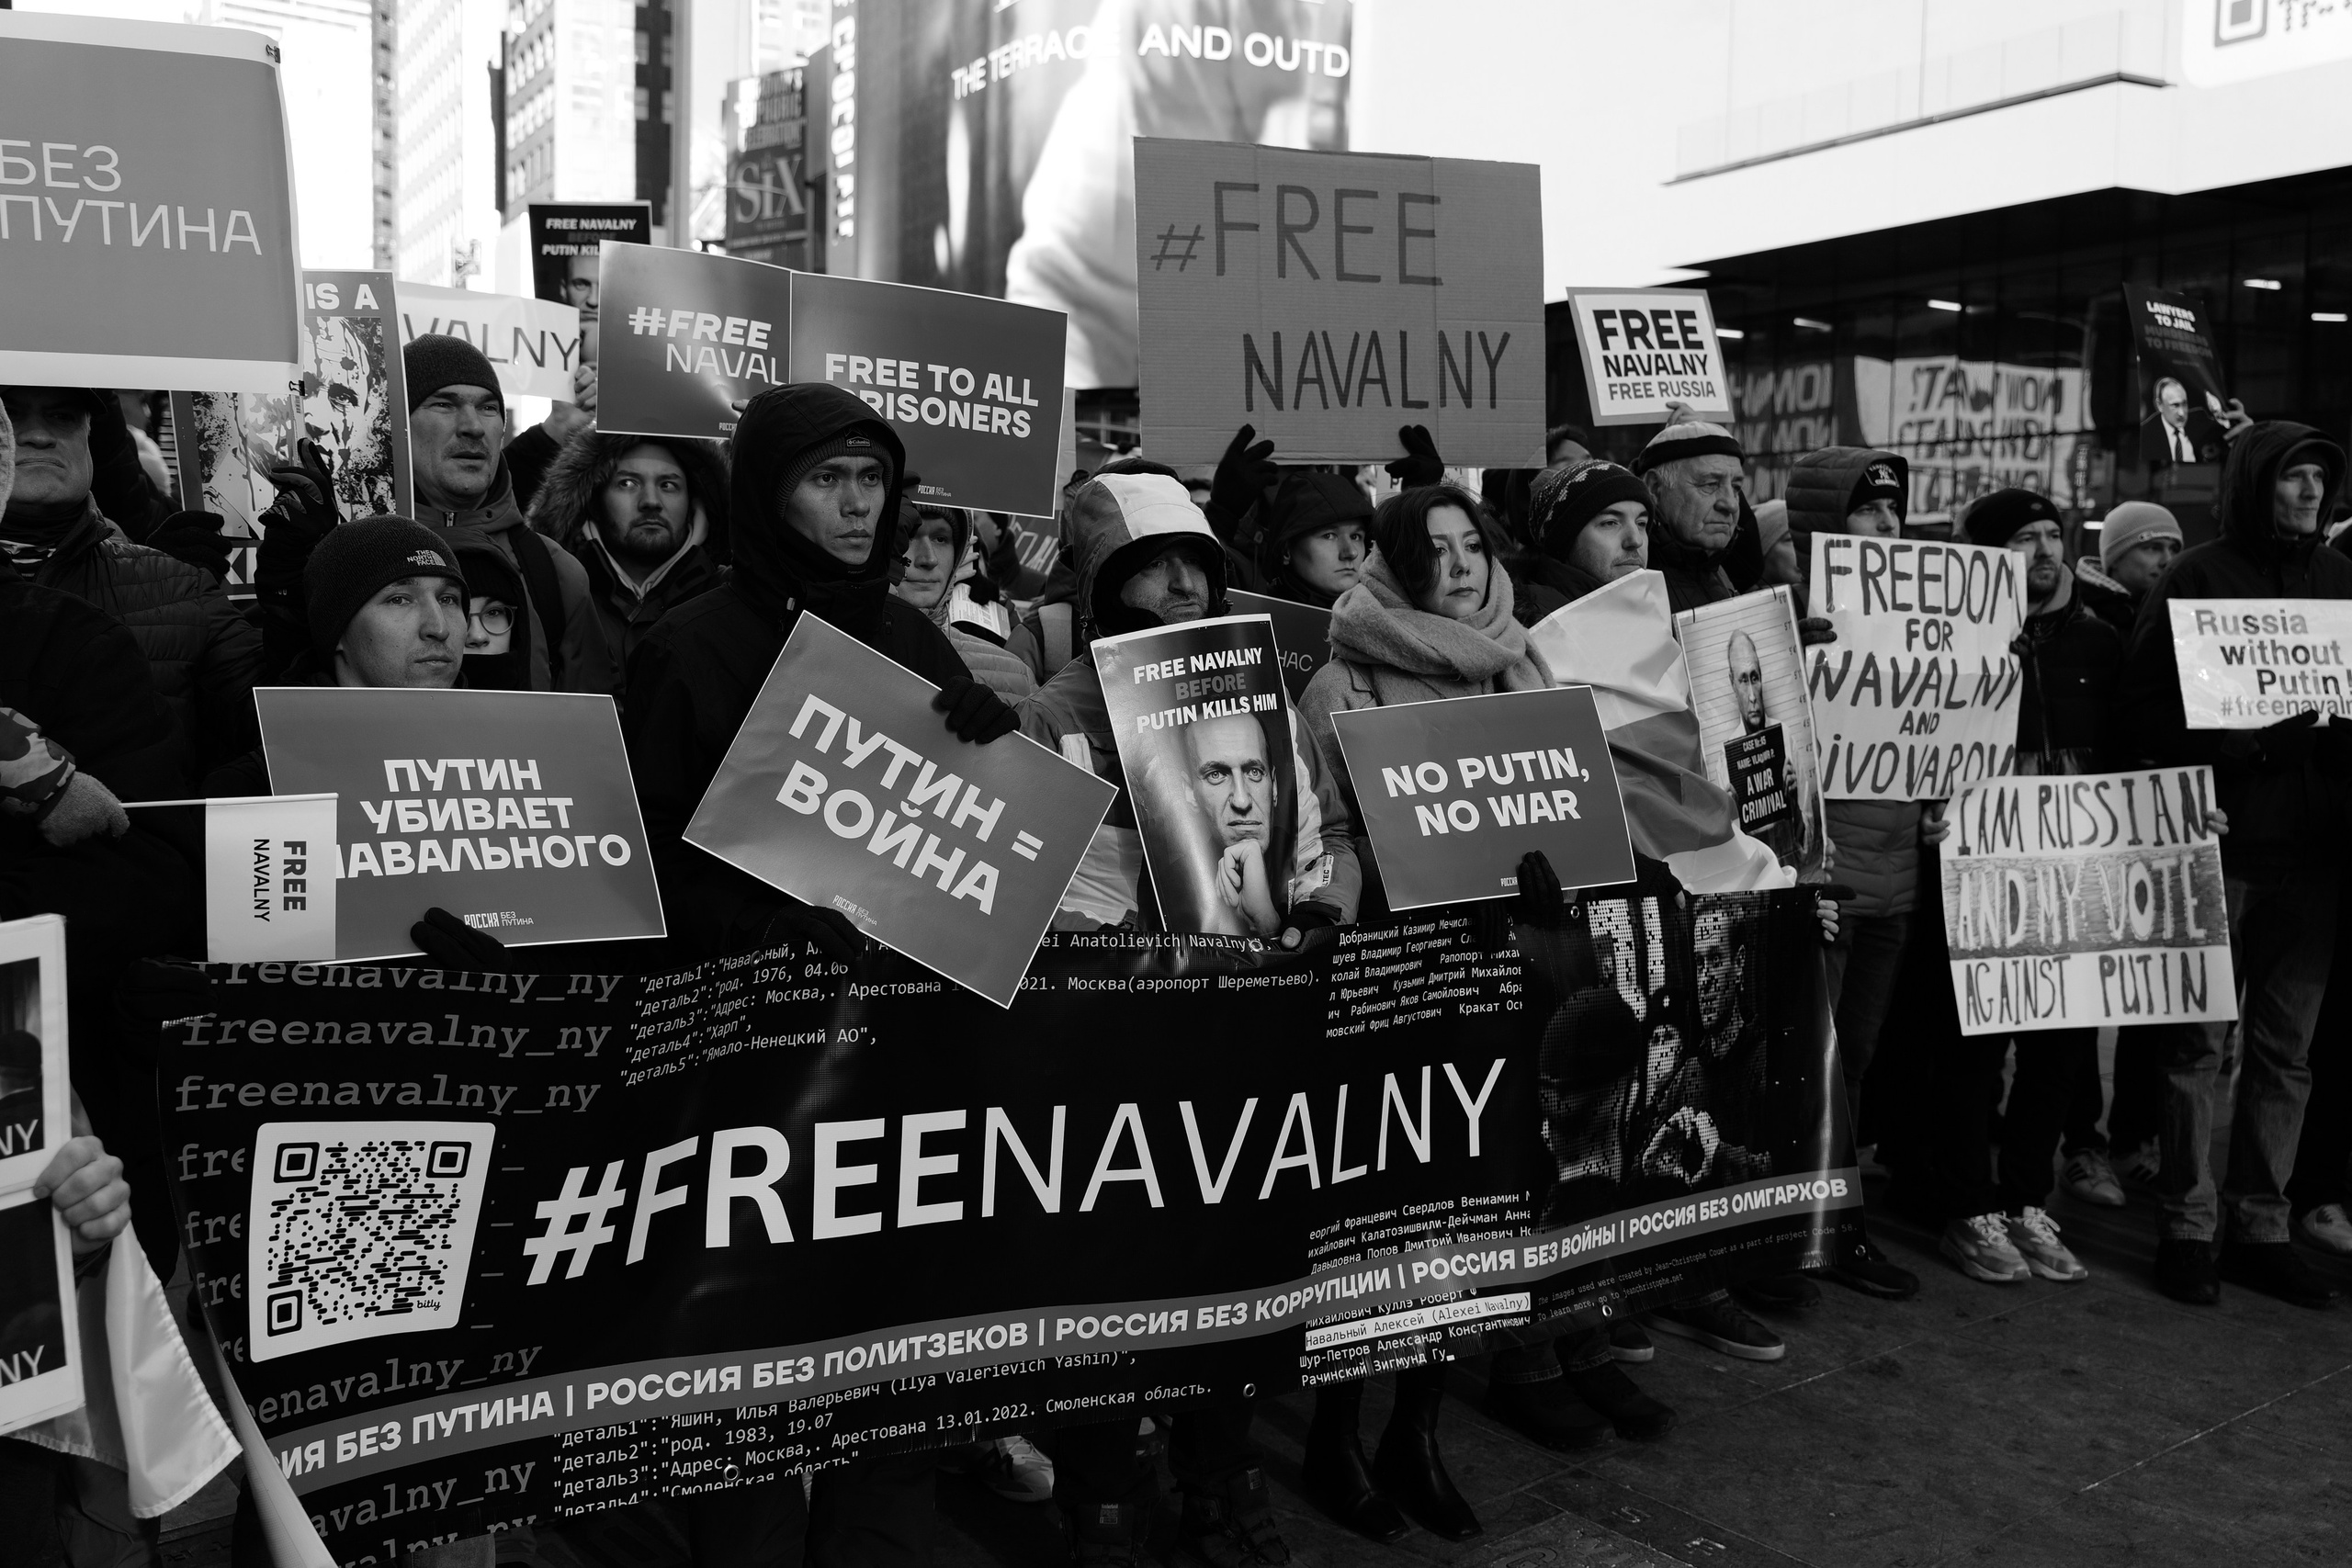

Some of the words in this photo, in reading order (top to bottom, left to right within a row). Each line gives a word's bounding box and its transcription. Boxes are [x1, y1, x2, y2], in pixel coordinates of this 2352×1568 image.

[951, 56, 987, 100] THE
[1137, 23, 1233, 61] AND
[1243, 31, 1351, 78] OUTD
[0, 140, 122, 192] БЕЗ
[0, 194, 263, 256] ПУТИНА
[545, 218, 578, 230] FREE
[579, 218, 638, 231] NAVALNY
[1150, 180, 1443, 287] #FREE
[541, 244, 579, 256] PUTIN
[305, 283, 340, 310] IS
[354, 283, 379, 310] A
[2146, 300, 2196, 322] LAWYERS
[628, 306, 772, 351] #FREE
[1592, 310, 1704, 351] FREE
[2154, 313, 2172, 327] TO
[2173, 317, 2196, 333] JAIL
[825, 353, 920, 390] FREE
[927, 364, 976, 397] TO
[982, 373, 1039, 408] ALL
[1242, 330, 1511, 412] NAVALNY
[1602, 354, 1708, 378] NAVALNY
[1608, 381, 1656, 400] FREE
[1657, 380, 1717, 399] RUSSIA
[406, 555, 434, 563] NORTH
[1905, 618, 1954, 652] FOR
[2195, 608, 2309, 636] Russia
[1133, 657, 1186, 684] FREE
[1190, 647, 1262, 673] NAVALNY
[2220, 639, 2344, 666] without
[1175, 672, 1247, 701] BEFORE
[1810, 648, 2021, 712] NAVALNY
[1136, 705, 1198, 734] PUTIN
[1202, 695, 1250, 720] KILLS
[1252, 693, 1278, 712] HIM
[1899, 710, 1940, 736] AND
[383, 759, 543, 793] ПУТИН
[787, 693, 1006, 843] ПУТИН
[1381, 761, 1449, 798] NO
[1457, 747, 1589, 789] PUTIN,
[1747, 775, 1755, 796] A
[1755, 767, 1774, 792] WAR
[360, 797, 573, 834] УБИВАЕТ
[1414, 799, 1480, 837] NO
[1487, 789, 1582, 827] WAR
[1958, 788, 1973, 856] I
[1978, 786, 2024, 854] AM
[2039, 769, 2208, 850] RUSSIAN
[775, 759, 1001, 916] ВОЙНА
[253, 838, 271, 923] NAVALNY
[283, 840, 307, 913] FREE
[500, 911, 516, 919] БЕЗ
[1957, 867, 2026, 951] AND
[2034, 861, 2084, 947] MY
[2096, 854, 2207, 942] VOTE
[502, 917, 534, 927] ПУТИНА
[1070, 933, 1182, 948] Anatolievich
[1339, 926, 1399, 947] Добраницкий
[1403, 922, 1435, 936] Казимир
[1331, 967, 1360, 983] колай
[1364, 960, 1422, 978] Владимирович
[1440, 951, 1484, 964] Рапопорт
[1332, 952, 1355, 965] шуев
[1361, 945, 1402, 962] Владимир
[1407, 936, 1452, 954] Георгиевич
[752, 965, 793, 985] 1976,
[848, 978, 942, 999] Арестована
[1340, 985, 1379, 1001] Юрьевич
[1393, 976, 1424, 991] Кузьмин
[1428, 968, 1465, 986] Дмитрий
[1966, 954, 2071, 1026] AGAINST
[2098, 951, 2208, 1018] PUTIN
[1326, 1021, 1365, 1039] мовский
[1369, 1017, 1389, 1032] Фриц
[1393, 1008, 1442, 1026] Августович
[1459, 1001, 1499, 1016] Кракат
[1351, 1000, 1396, 1017] Рабинович
[1400, 995, 1419, 1007] Яков
[1422, 986, 1479, 1002] Самойлович
[181, 1013, 613, 1058] freenavalny_ny
[175, 1073, 602, 1117] freenavalny_ny
[521, 1057, 1507, 1286] #FREENAVALNY
[1309, 1220, 1340, 1240] еоргий
[1344, 1208, 1397, 1229] Францевич
[1402, 1200, 1454, 1217] Свердлов
[1461, 1192, 1519, 1208] Вениамин
[1308, 1235, 1356, 1258] ихайлович
[1361, 1213, 1498, 1243] Калатозишвили-Дейчман
[1311, 1253, 1362, 1275] Давыдовна
[1367, 1244, 1398, 1259] Попов
[1404, 1232, 1453, 1252] Дмитрий
[1456, 1228, 1512, 1244] Иванович
[1776, 1229, 1807, 1245] project
[337, 1421, 401, 1464] БЕЗ
[413, 1391, 555, 1445] ПУТИНА
[587, 1365, 741, 1409] РОССИЯ
[753, 1356, 815, 1389] БЕЗ
[823, 1322, 1028, 1378] ПОЛИТЗЕКОВ
[1055, 1309, 1189, 1342] РОССИЯ
[1196, 1303, 1248, 1330] БЕЗ
[1254, 1268, 1391, 1322] КОРРУПЦИИ
[1414, 1249, 1516, 1284] РОССИЯ
[1523, 1235, 1558, 1269] БЕЗ
[1561, 1223, 1615, 1260] ВОЙНЫ
[1630, 1205, 1696, 1238] РОССИЯ
[1699, 1195, 1729, 1222] БЕЗ
[1732, 1179, 1849, 1213] ОЛИГАРХОВ
[416, 1298, 441, 1312] bitly
[1306, 1325, 1367, 1347] Навальный
[1374, 1313, 1425, 1333] Алексей
[1431, 1303, 1482, 1324] (Alexei
[1485, 1295, 1530, 1313] Navalny)
[1299, 1345, 1371, 1369] Шур-Петров
[1377, 1330, 1442, 1352] Александр
[1448, 1315, 1531, 1338] Константинович
[788, 1383, 880, 1414] Валерьевич
[945, 1359, 1046, 1384] Valerievich
[1302, 1363, 1368, 1387] Рачинский
[1374, 1353, 1427, 1372] Зигмунд
[725, 1427, 775, 1449] 1983,
[787, 1413, 833, 1436] 19.07
[831, 1420, 926, 1449] Арестована
[936, 1403, 1035, 1430] 13.01.2022.
[1046, 1391, 1136, 1415] Смоленская
[1144, 1382, 1212, 1403] область.
